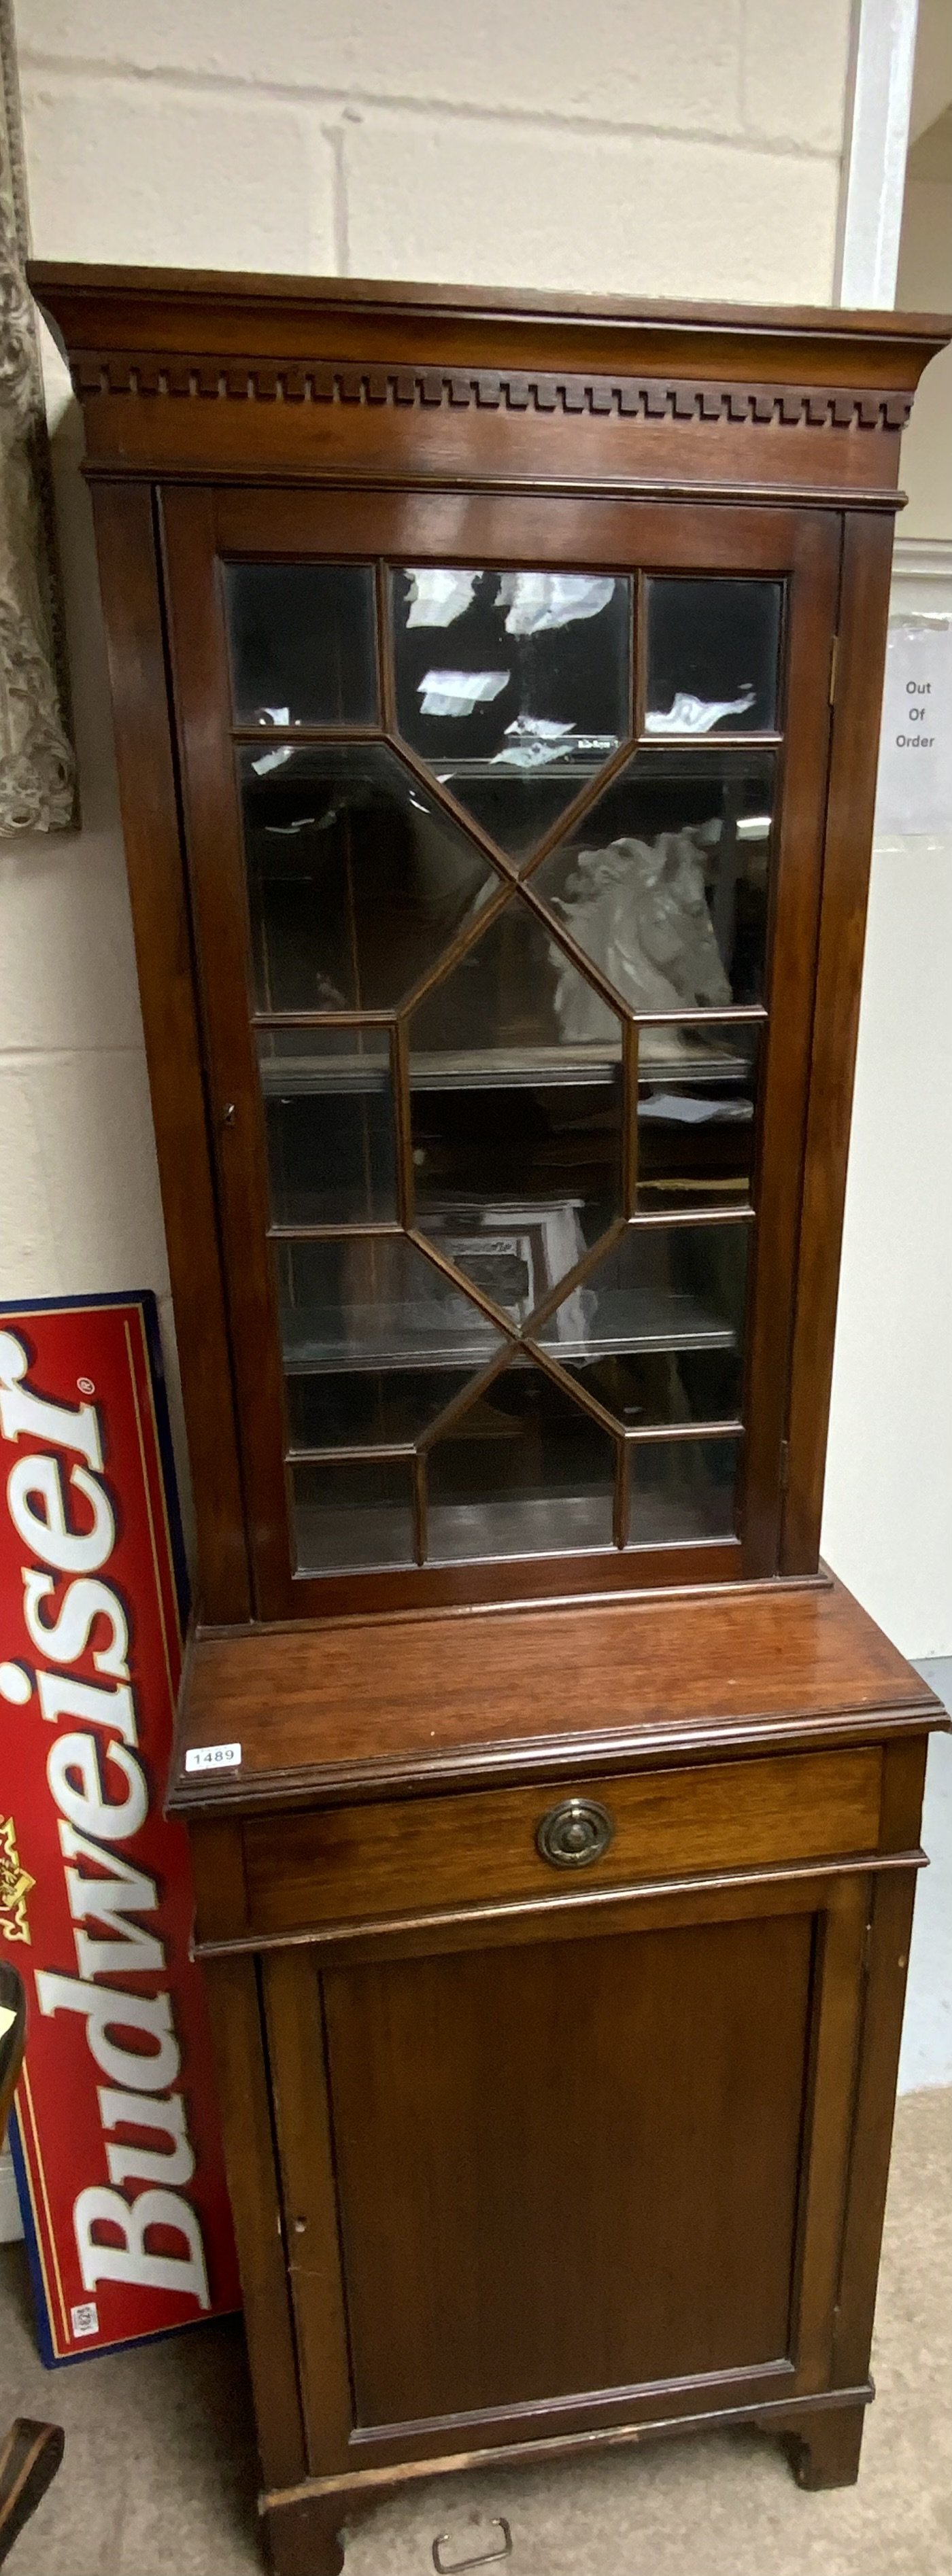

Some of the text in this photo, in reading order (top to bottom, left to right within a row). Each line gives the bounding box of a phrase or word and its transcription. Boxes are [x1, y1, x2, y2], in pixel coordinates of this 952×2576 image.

[906, 681, 931, 694] Out
[908, 708, 925, 721] Of
[896, 735, 935, 748] Order
[194, 1750, 235, 1764] 1489
[0, 1330, 211, 2310] Budweiser
